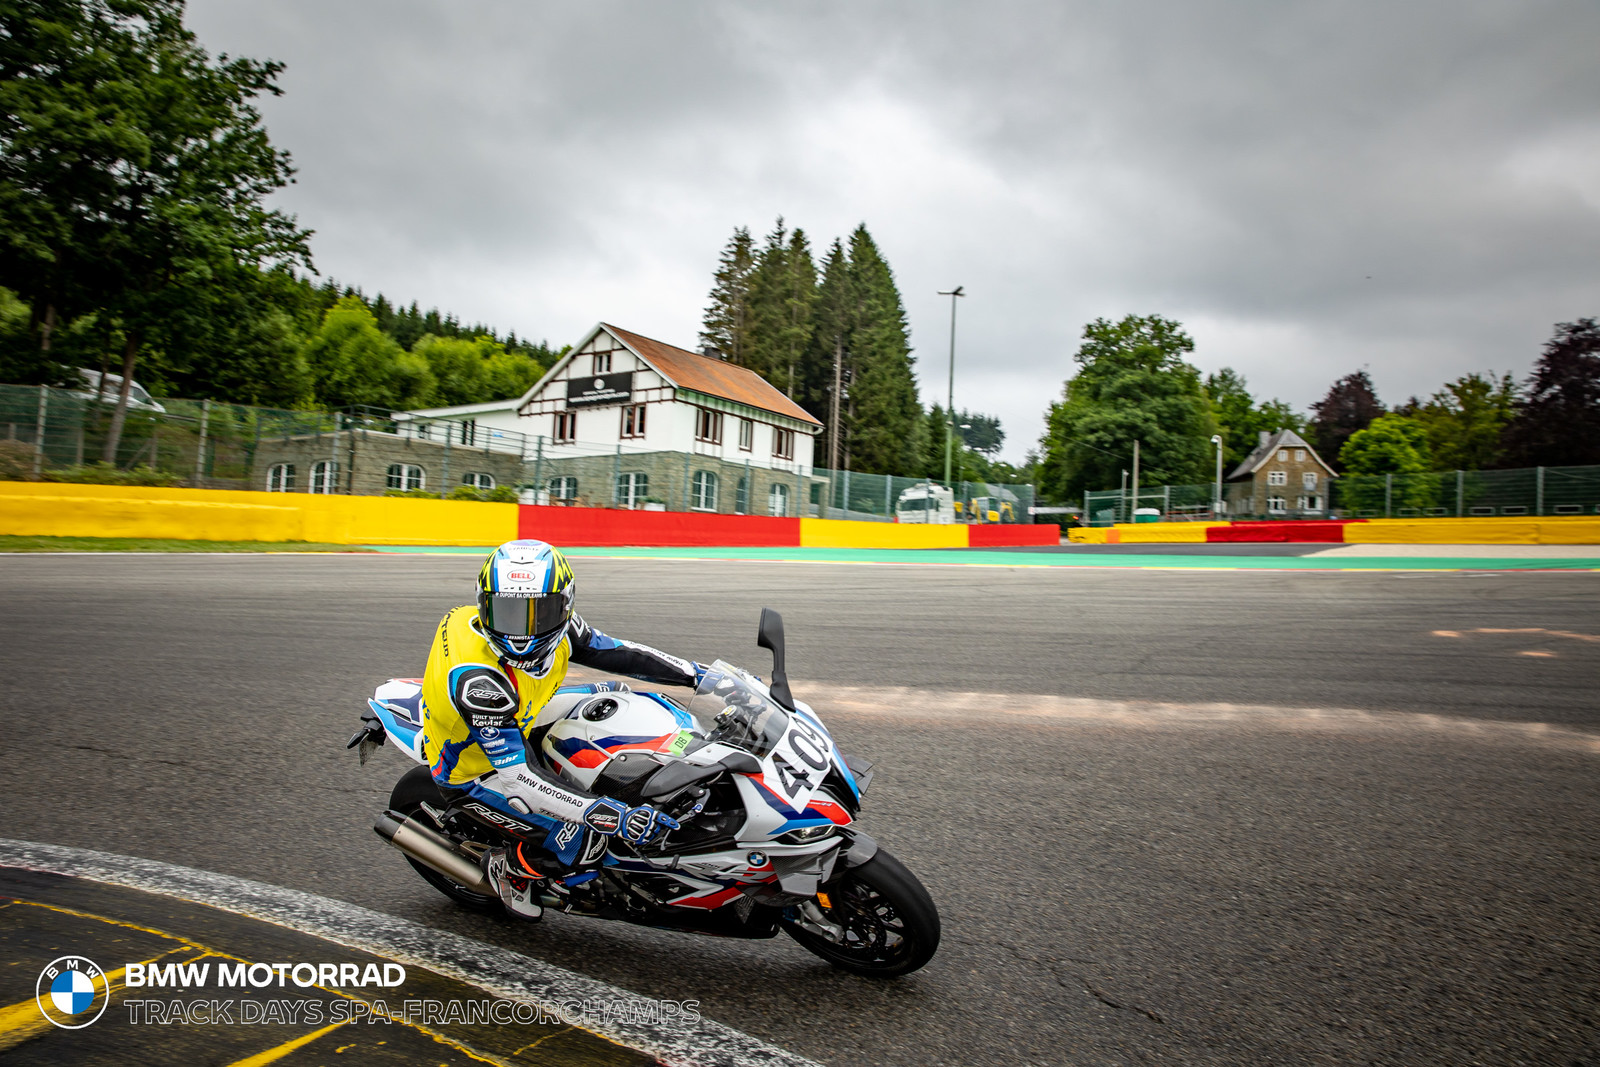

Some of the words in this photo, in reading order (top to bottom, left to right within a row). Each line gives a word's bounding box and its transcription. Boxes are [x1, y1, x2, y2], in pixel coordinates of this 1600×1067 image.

[510, 572, 532, 580] BELL
[467, 688, 506, 700] RST
[771, 715, 829, 800] 409
[516, 773, 538, 788] BMW
[538, 783, 584, 808] MOTORRAD
[462, 802, 533, 831] RST
